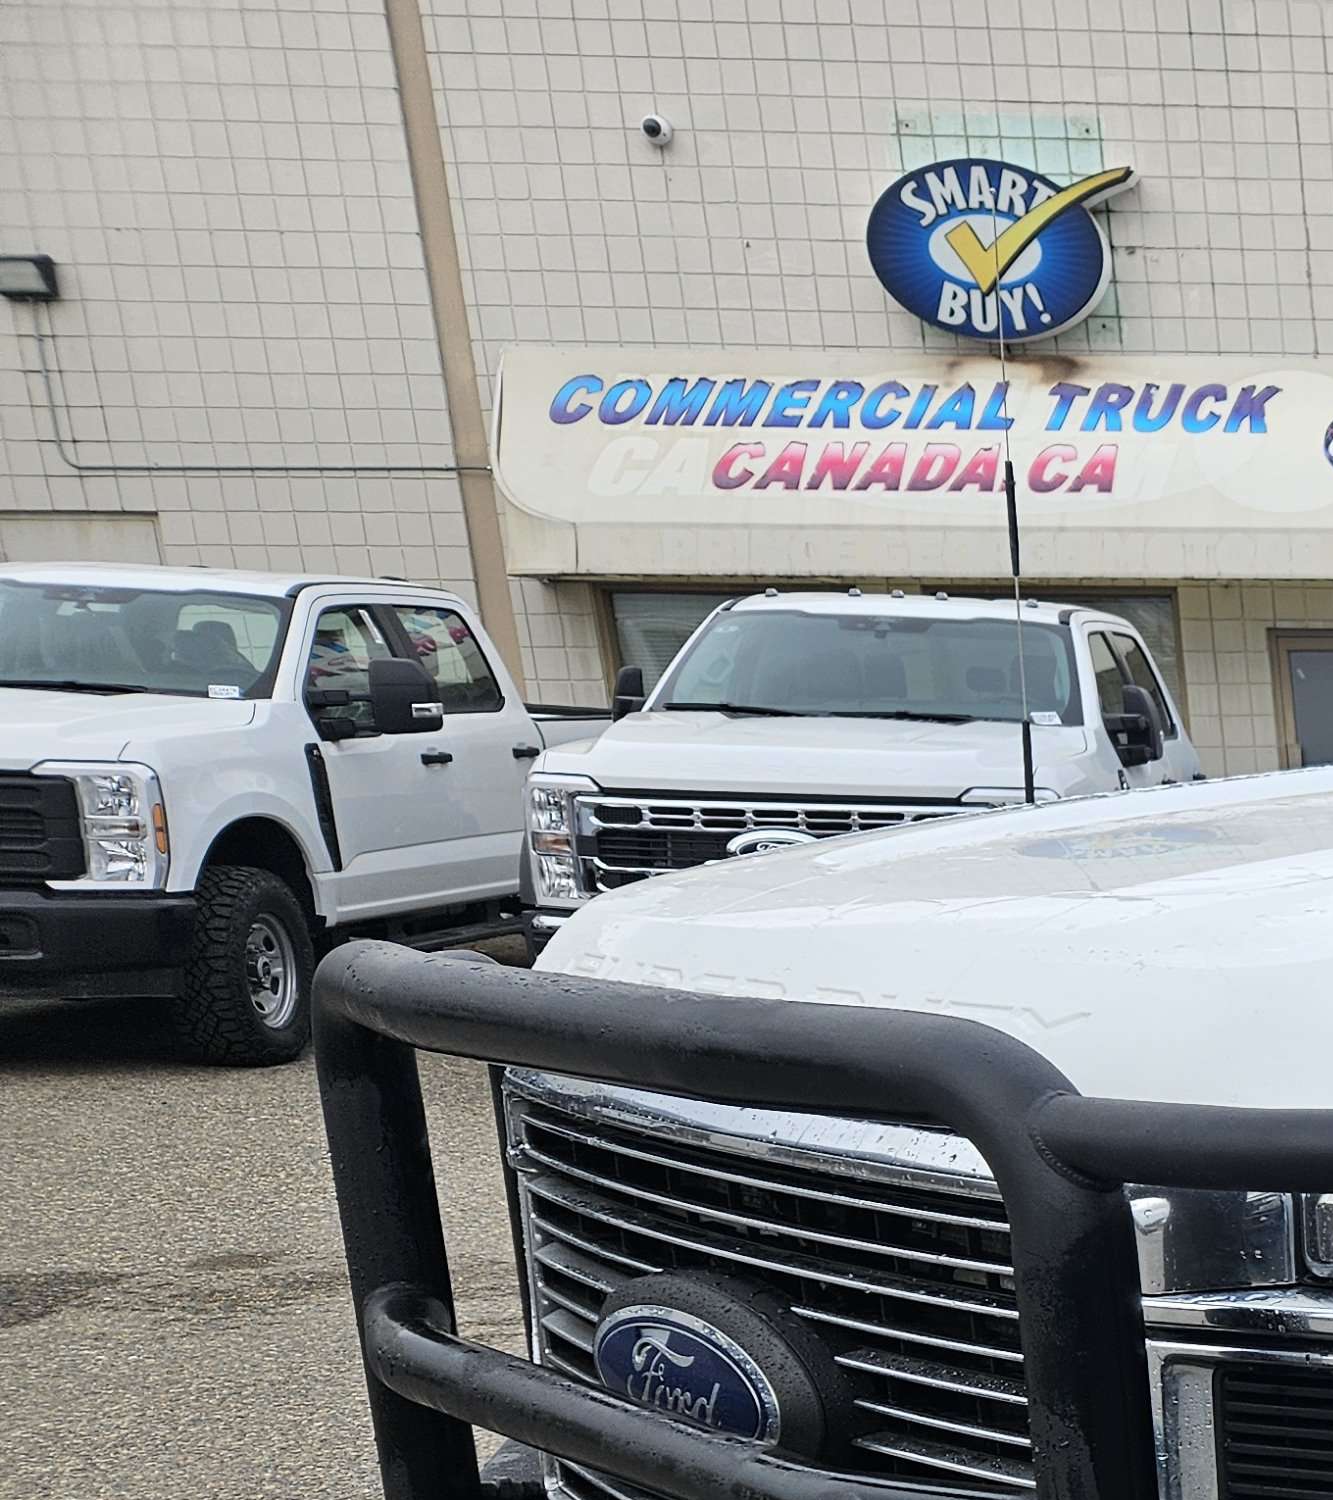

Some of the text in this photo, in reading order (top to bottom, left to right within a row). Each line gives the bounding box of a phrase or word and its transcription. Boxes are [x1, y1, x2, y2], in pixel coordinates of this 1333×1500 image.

[900, 165, 1056, 227] SMART
[936, 280, 1052, 333] BUY!
[547, 373, 1284, 434] COMMERCIAL TRUCK
[627, 1336, 722, 1426] Ford
